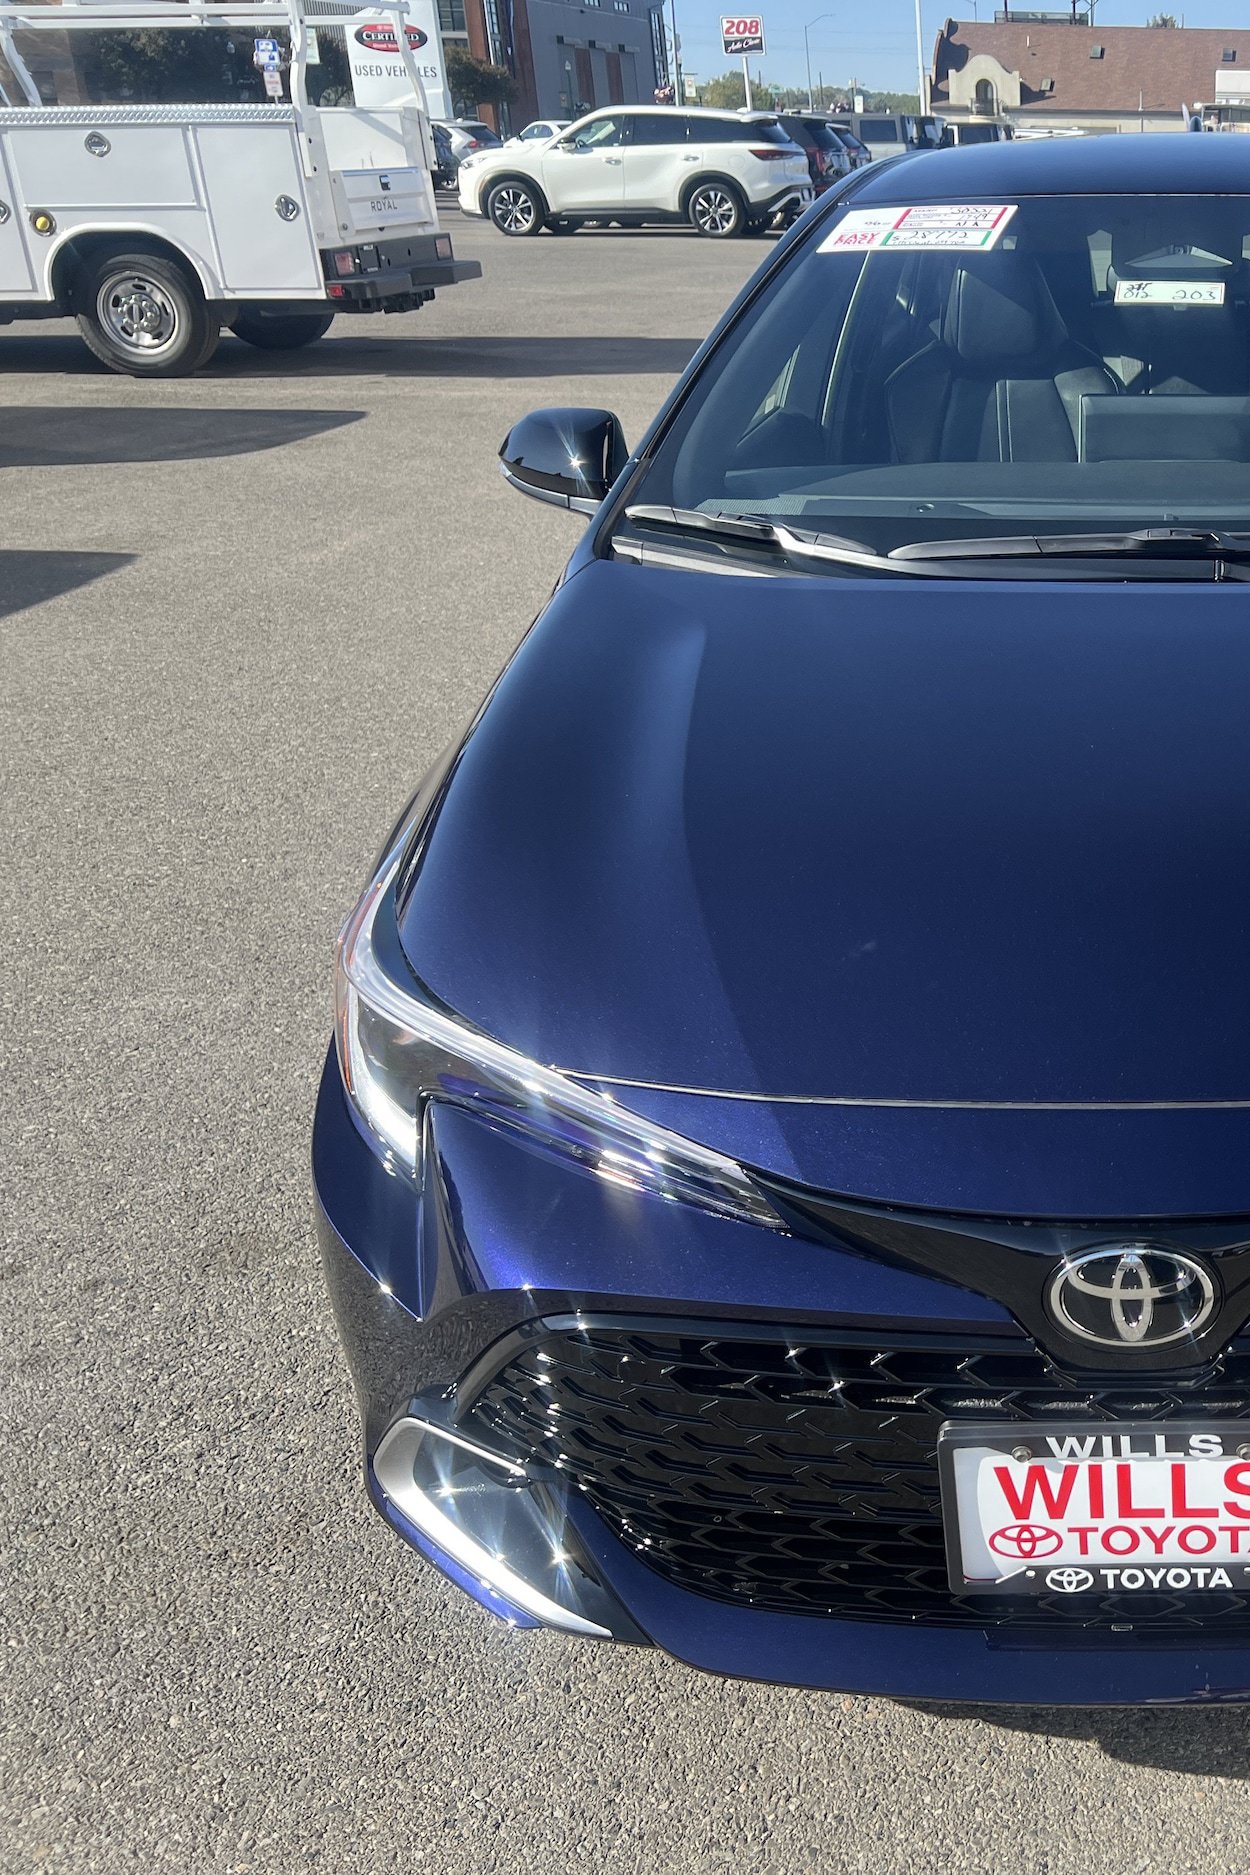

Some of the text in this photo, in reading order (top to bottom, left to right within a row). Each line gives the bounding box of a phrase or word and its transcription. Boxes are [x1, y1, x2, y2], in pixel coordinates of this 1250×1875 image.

[724, 19, 760, 35] 208
[362, 31, 420, 41] CERTID
[354, 64, 437, 78] USED VEHLES
[370, 200, 398, 212] ROYAL
[1045, 1433, 1224, 1460] WILLS
[1100, 1566, 1234, 1590] TOYOTA
